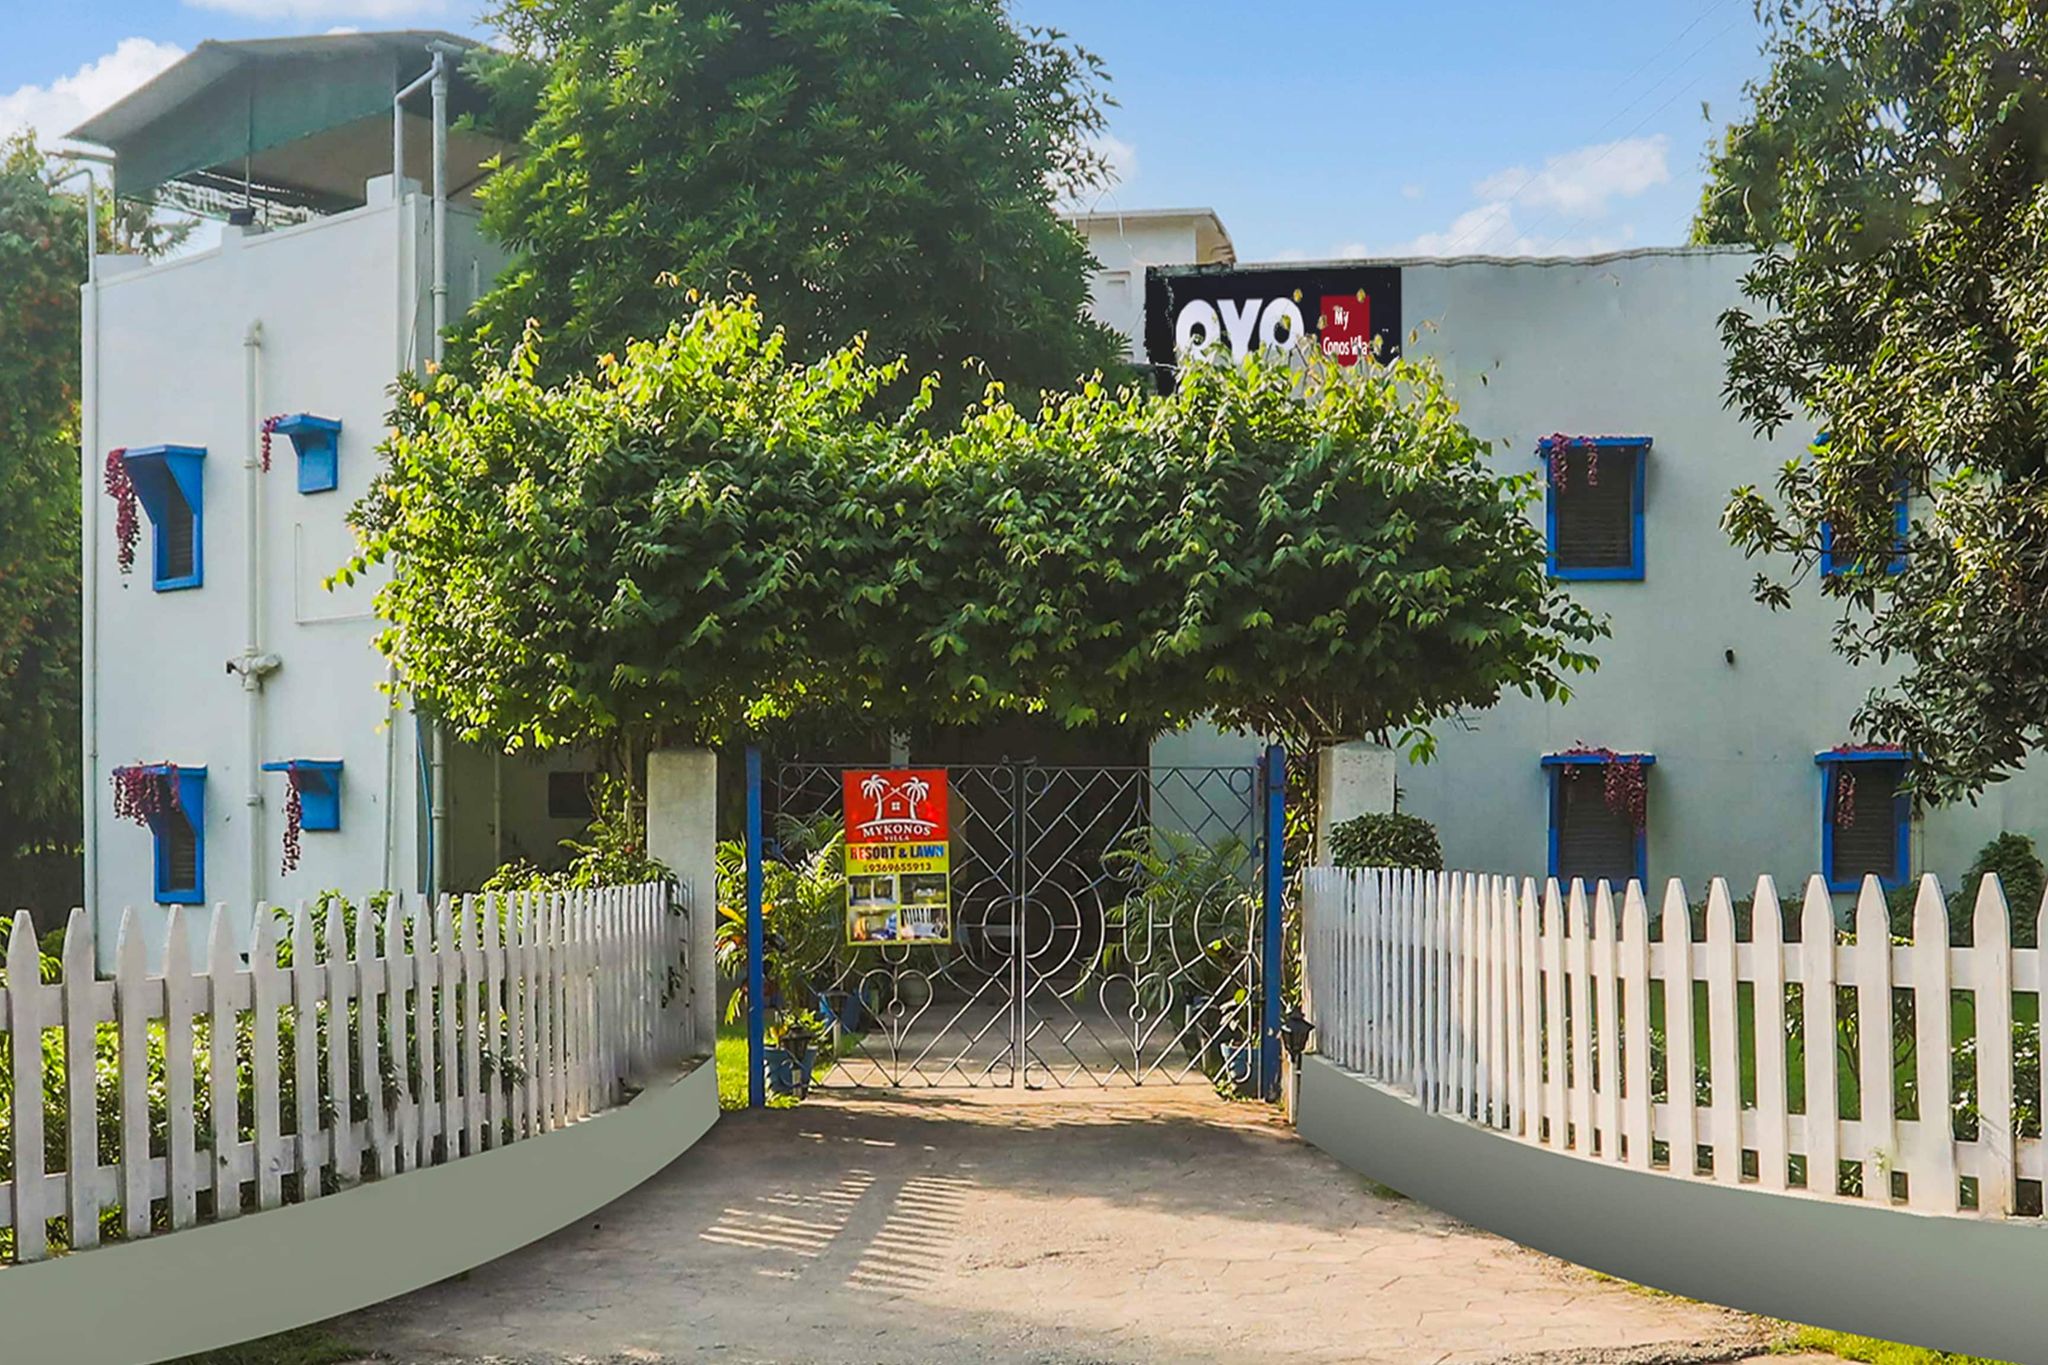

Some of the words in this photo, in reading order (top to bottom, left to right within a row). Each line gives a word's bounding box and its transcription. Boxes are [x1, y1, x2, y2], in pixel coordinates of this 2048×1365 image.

[1334, 306, 1350, 331] My
[1175, 297, 1305, 363] OYO
[863, 824, 931, 838] MYKONOS
[851, 846, 896, 860] RESORT
[899, 848, 908, 858] &
[911, 845, 944, 857] LAWN
